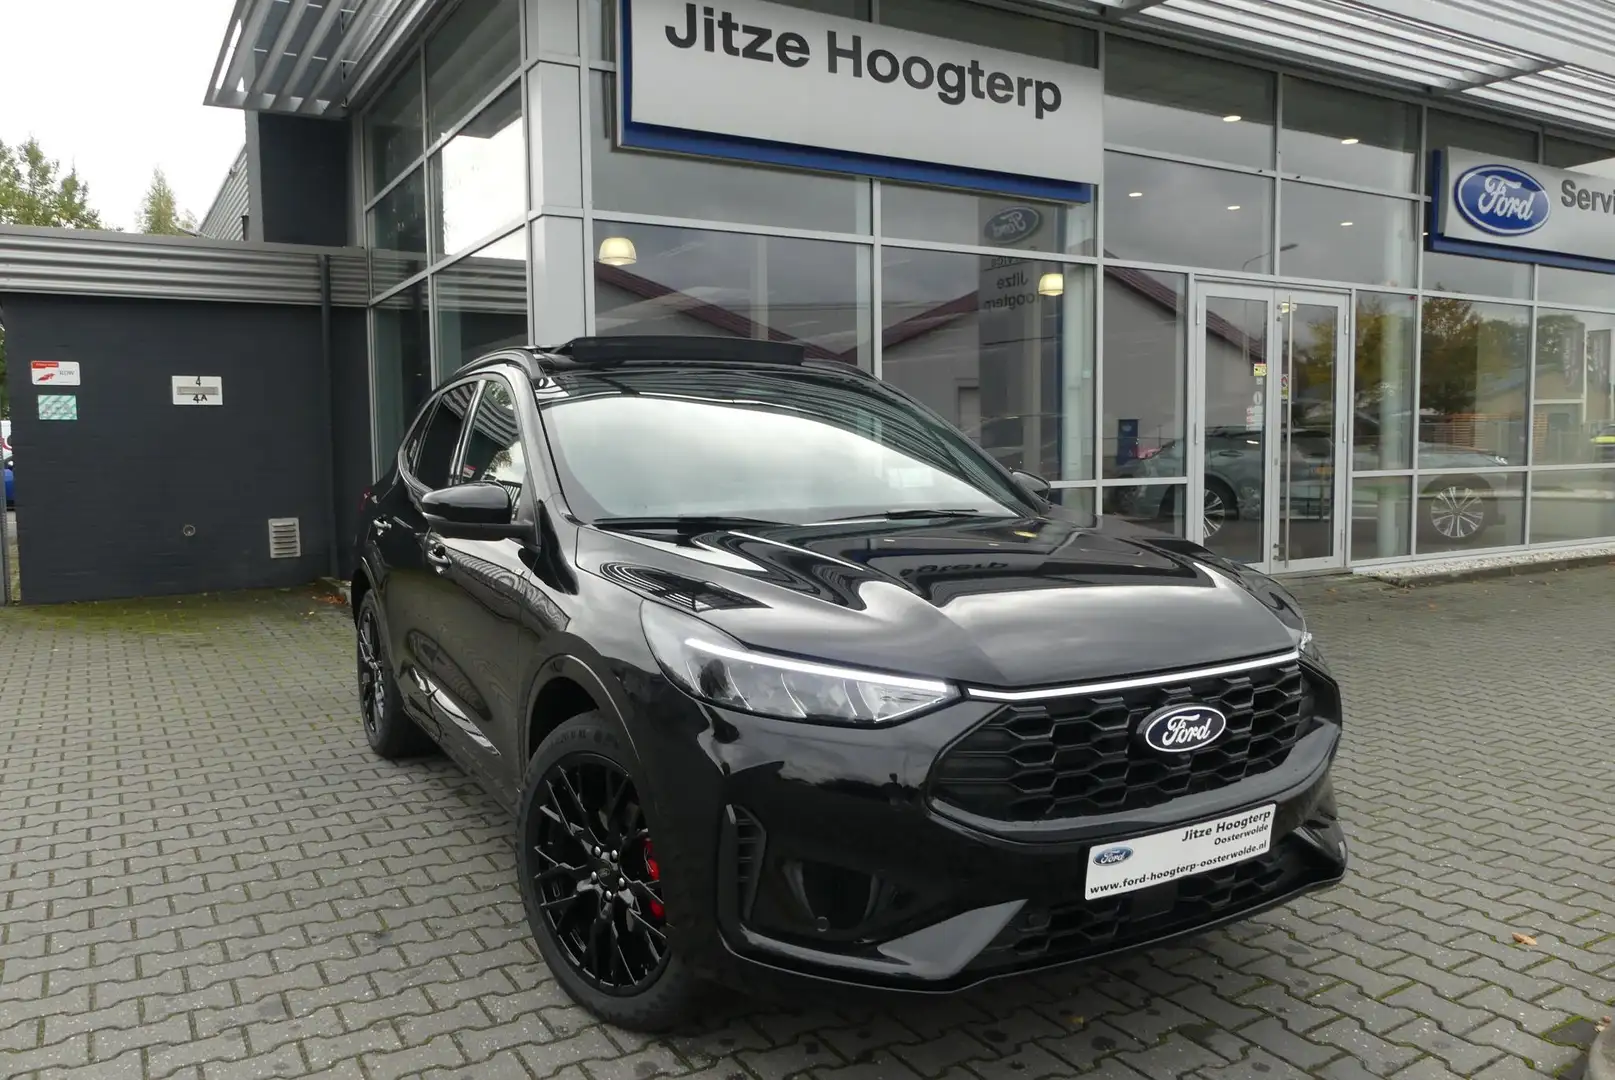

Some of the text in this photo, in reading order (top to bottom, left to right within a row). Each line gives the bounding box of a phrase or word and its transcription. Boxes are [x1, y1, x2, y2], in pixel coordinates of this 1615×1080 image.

[665, 3, 1062, 120] Jitze Hoogterp
[1478, 175, 1535, 221] Ford
[195, 376, 202, 387] 4
[192, 393, 208, 404] 4A
[1162, 714, 1212, 746] Ford
[1182, 811, 1271, 842] Jitze Hoogterp
[1214, 824, 1269, 846] Oosterwolde
[1089, 841, 1267, 894] www.ford-hoogterp-oosterwolde.nl
[1100, 850, 1127, 864] Ford
